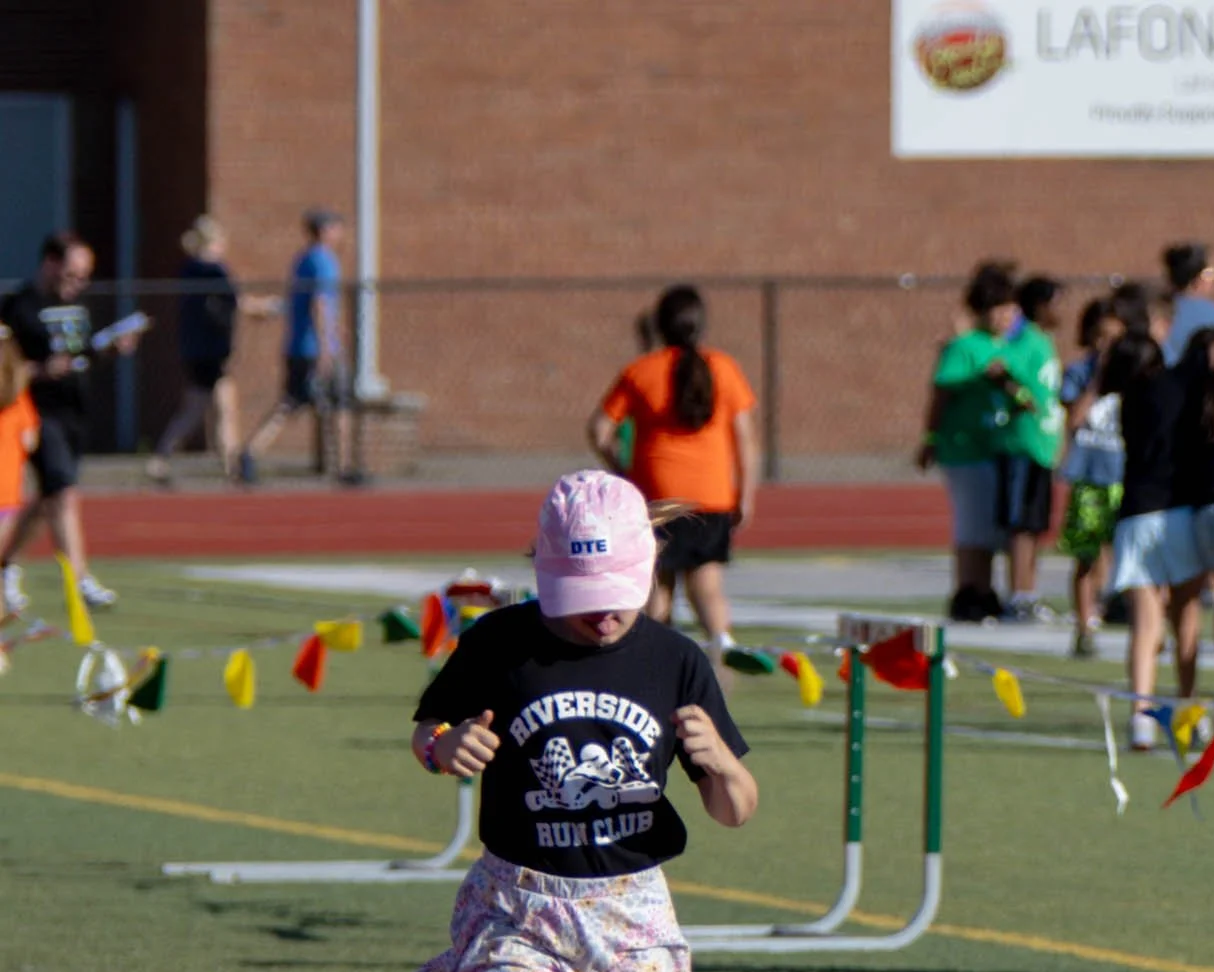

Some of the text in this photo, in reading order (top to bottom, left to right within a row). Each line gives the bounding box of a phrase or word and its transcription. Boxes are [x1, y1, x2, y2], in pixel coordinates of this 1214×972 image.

[571, 539, 607, 555] DTE
[508, 690, 662, 748] RIVERSIDE
[536, 810, 654, 848] RUN CLUB
